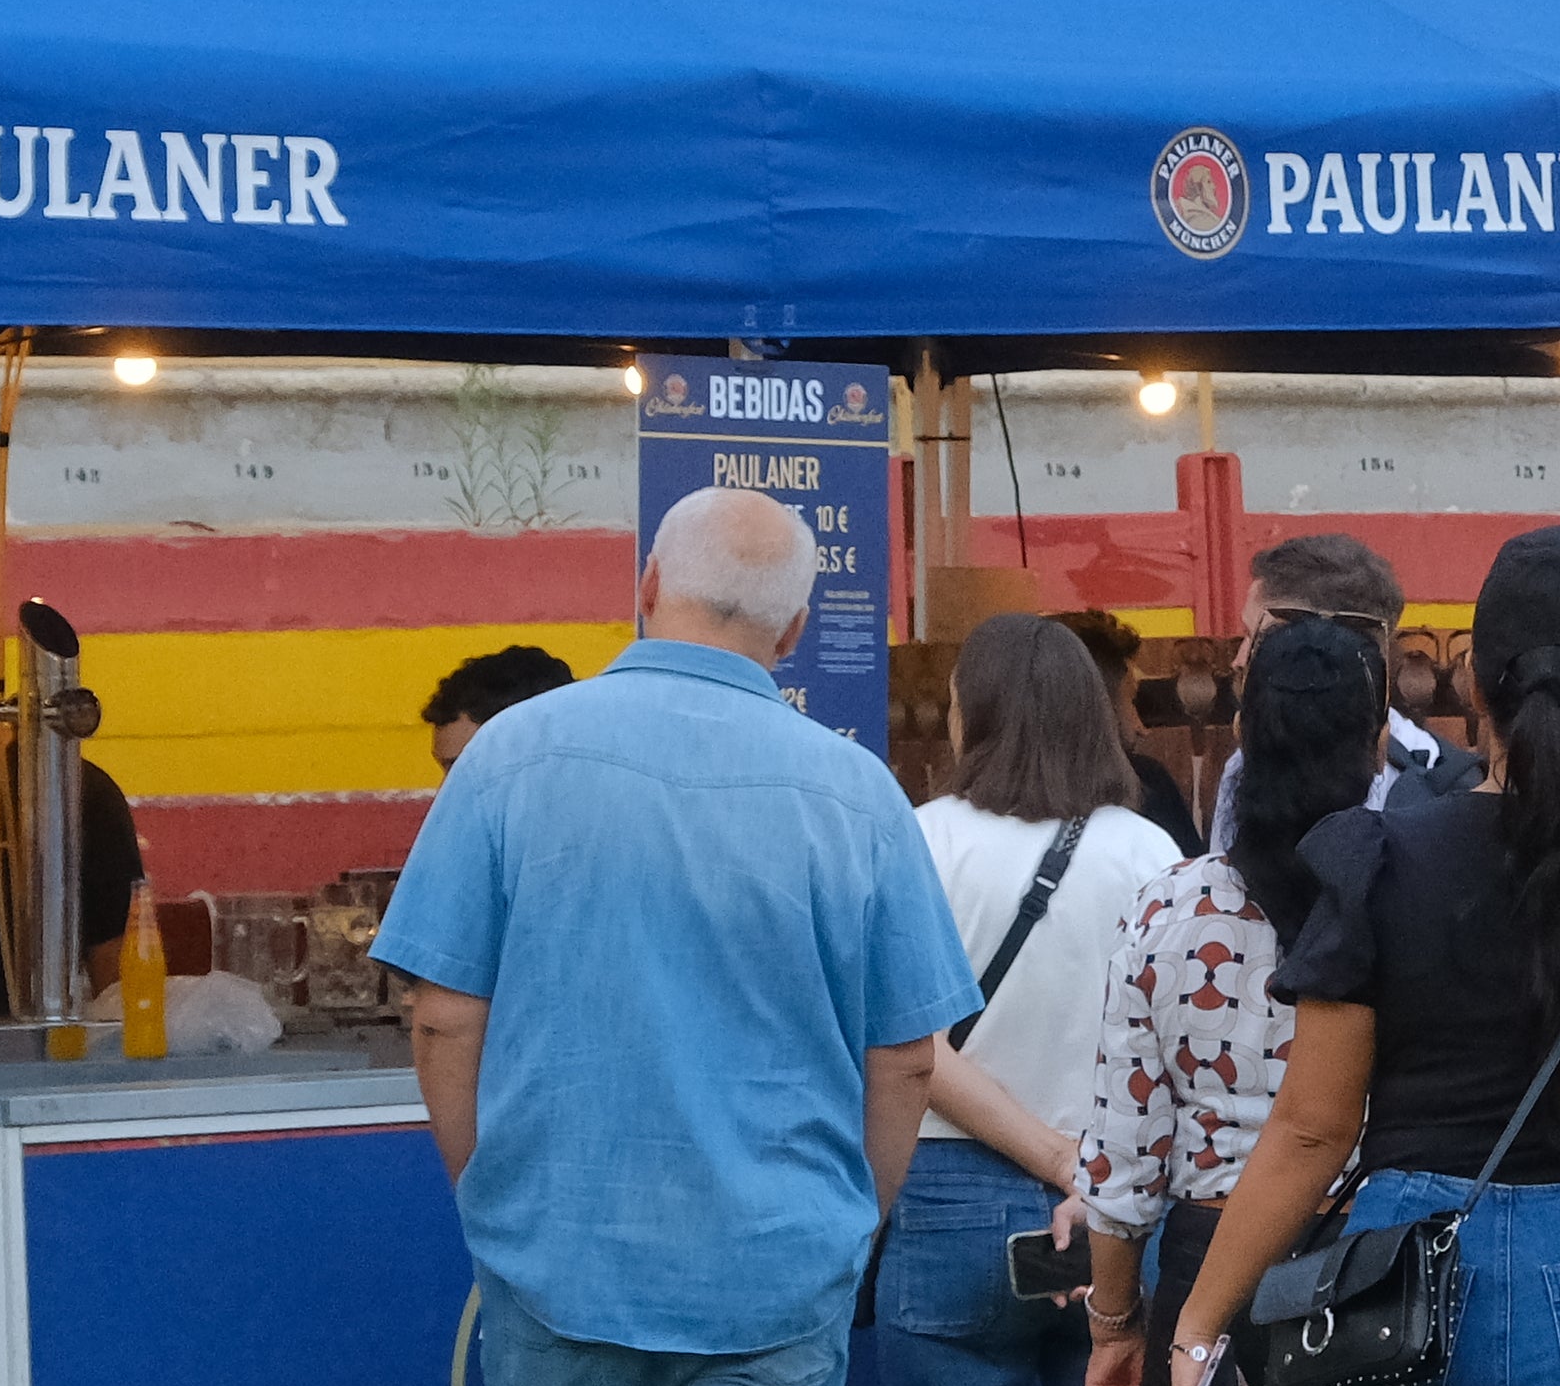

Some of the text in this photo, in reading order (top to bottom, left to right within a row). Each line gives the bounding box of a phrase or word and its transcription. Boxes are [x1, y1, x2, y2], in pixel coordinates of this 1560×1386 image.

[1158, 135, 1241, 181] PAULANER
[709, 375, 824, 423] BEBIDAS
[713, 453, 821, 491] PAULANER
